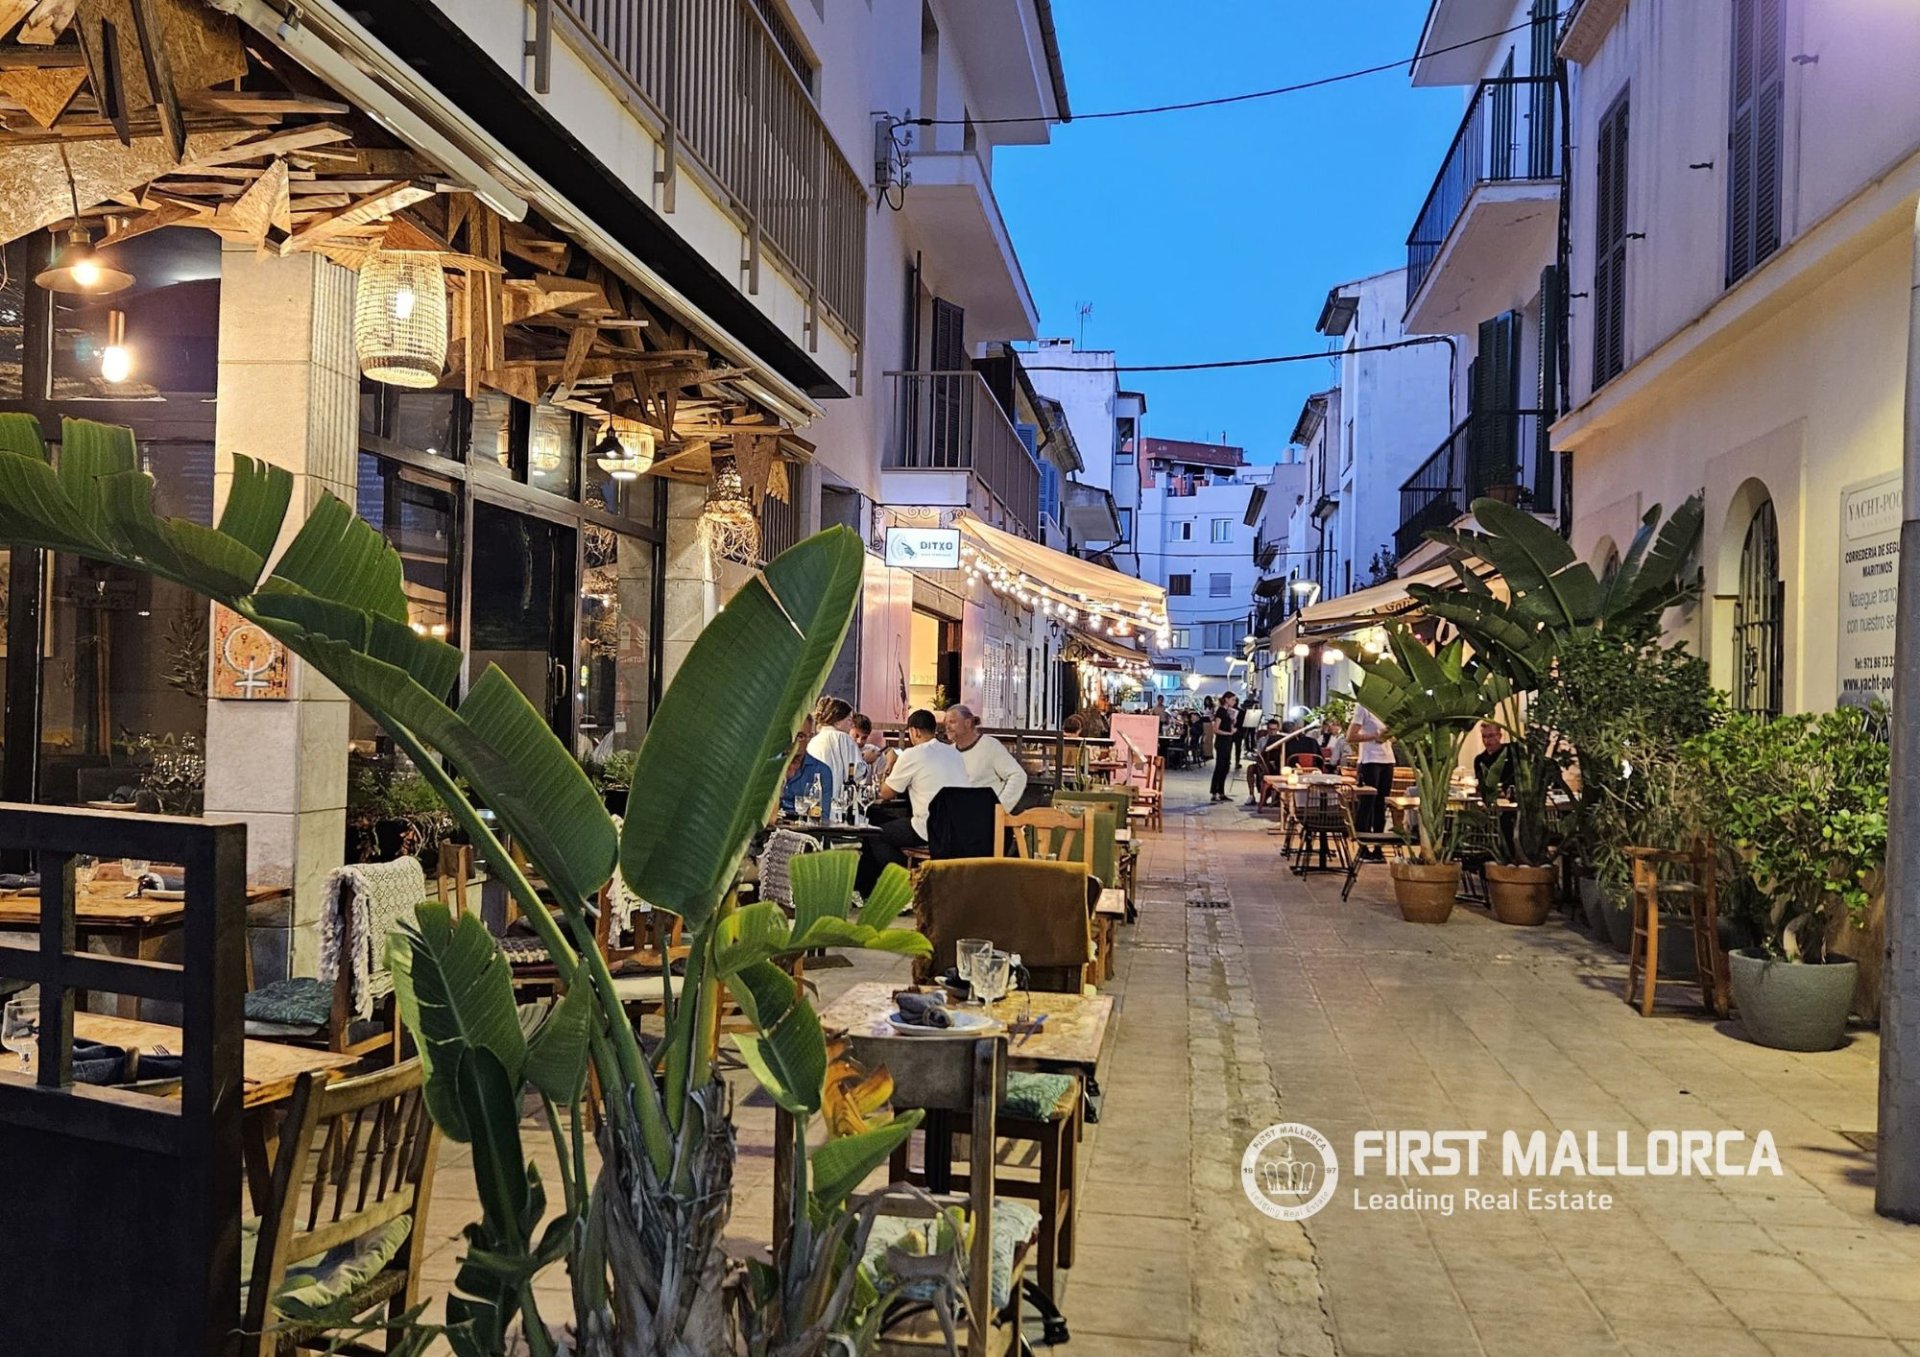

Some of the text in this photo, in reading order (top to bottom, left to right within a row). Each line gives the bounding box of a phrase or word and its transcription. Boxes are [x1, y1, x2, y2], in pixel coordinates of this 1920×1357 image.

[920, 541, 953, 550] DITXO
[1878, 544, 1885, 557] DE
[1849, 590, 1877, 610] Navegue
[1846, 614, 1896, 634] con nuestro se
[1863, 657, 1873, 669] 971
